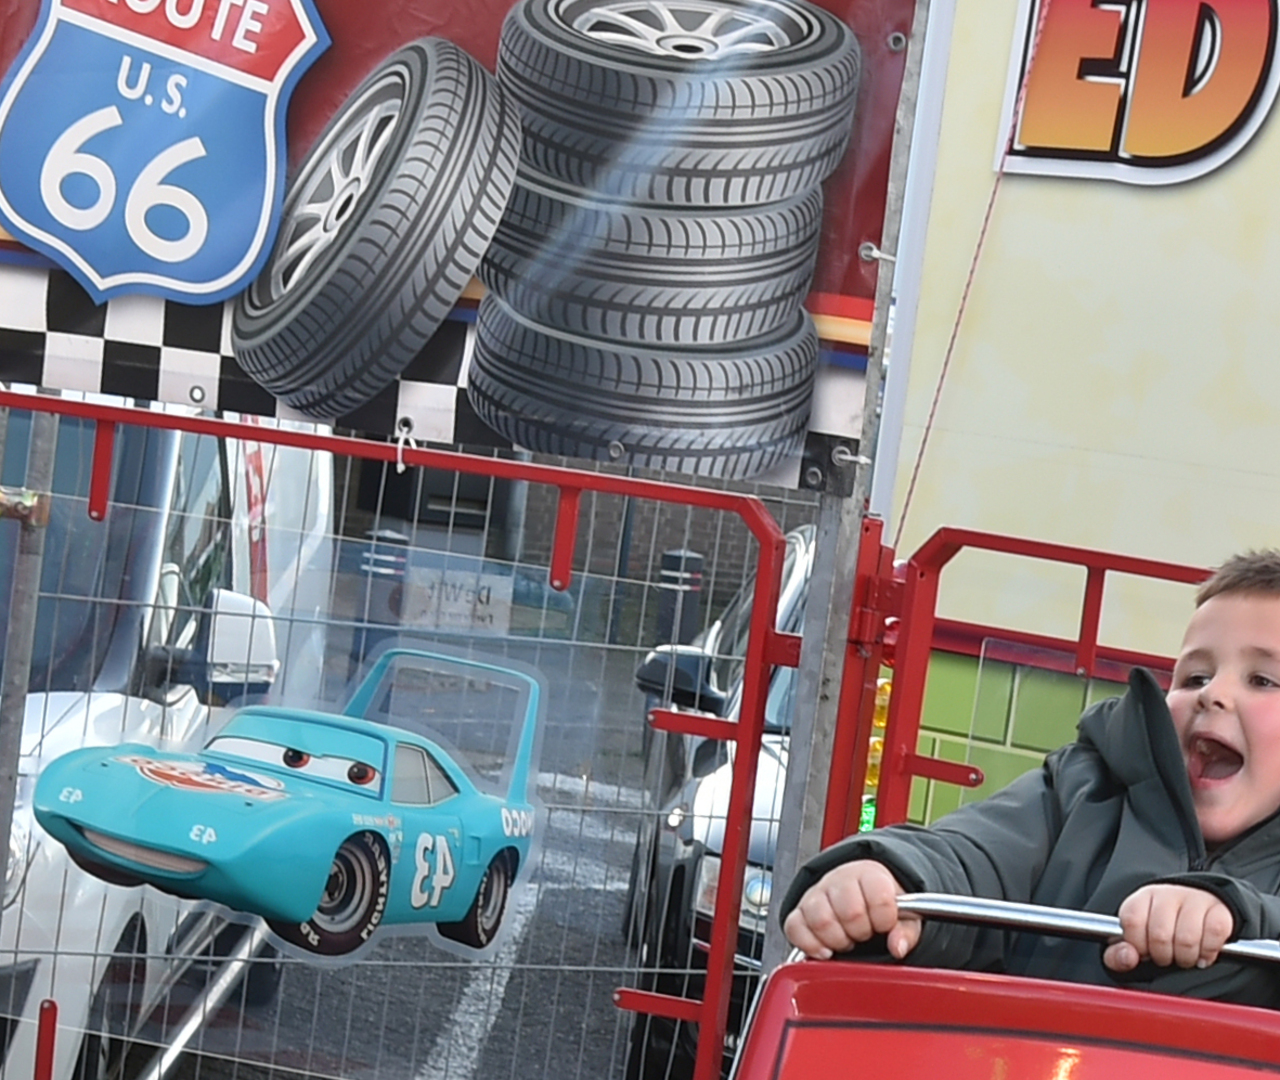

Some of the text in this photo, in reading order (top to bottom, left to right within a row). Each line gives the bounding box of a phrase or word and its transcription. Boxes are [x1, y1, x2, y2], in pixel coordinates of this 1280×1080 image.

[106, 0, 269, 54] UTE
[117, 55, 188, 119] U.S.
[40, 104, 208, 263] 66
